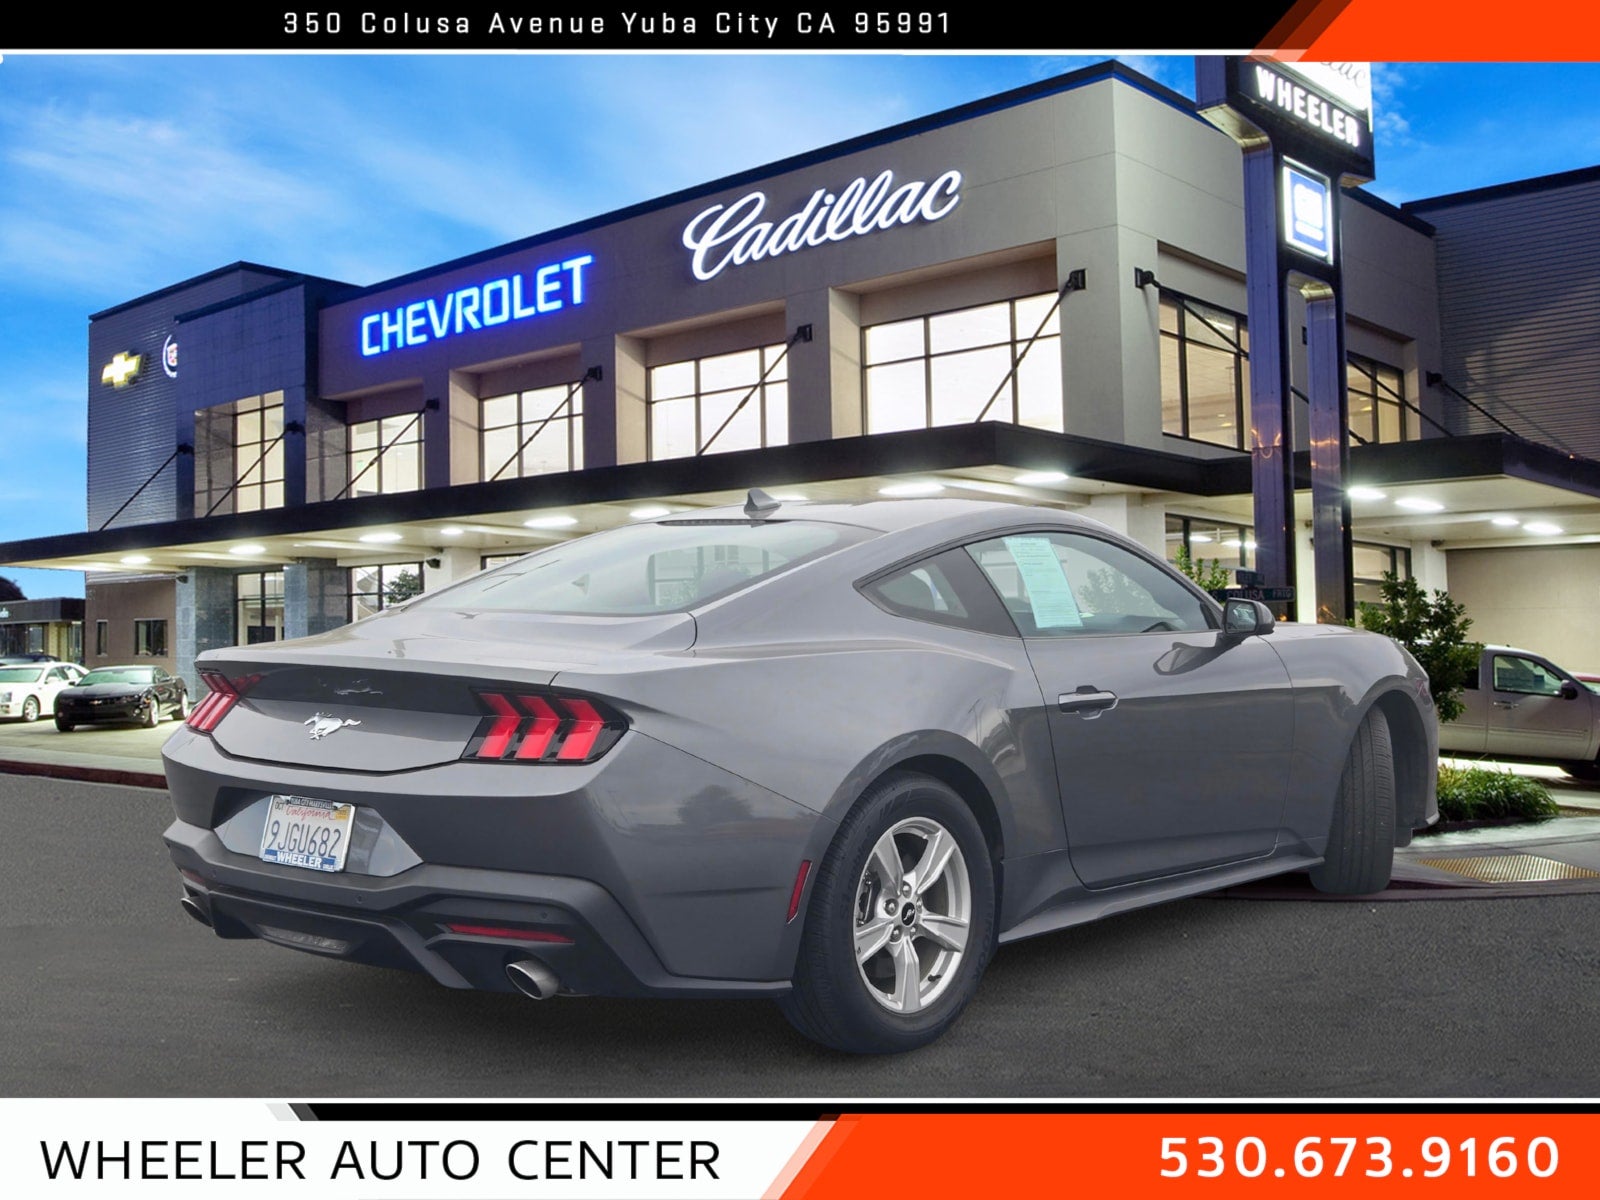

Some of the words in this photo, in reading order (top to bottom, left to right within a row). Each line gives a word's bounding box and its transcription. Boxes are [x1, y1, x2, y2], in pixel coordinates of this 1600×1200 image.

[1255, 64, 1360, 148] WHEELER
[682, 169, 963, 281] Cadillac
[361, 254, 594, 357] CHEVROLET
[267, 820, 342, 859] 9JGU682
[285, 804, 337, 822] California
[276, 851, 323, 869] WHEELER
